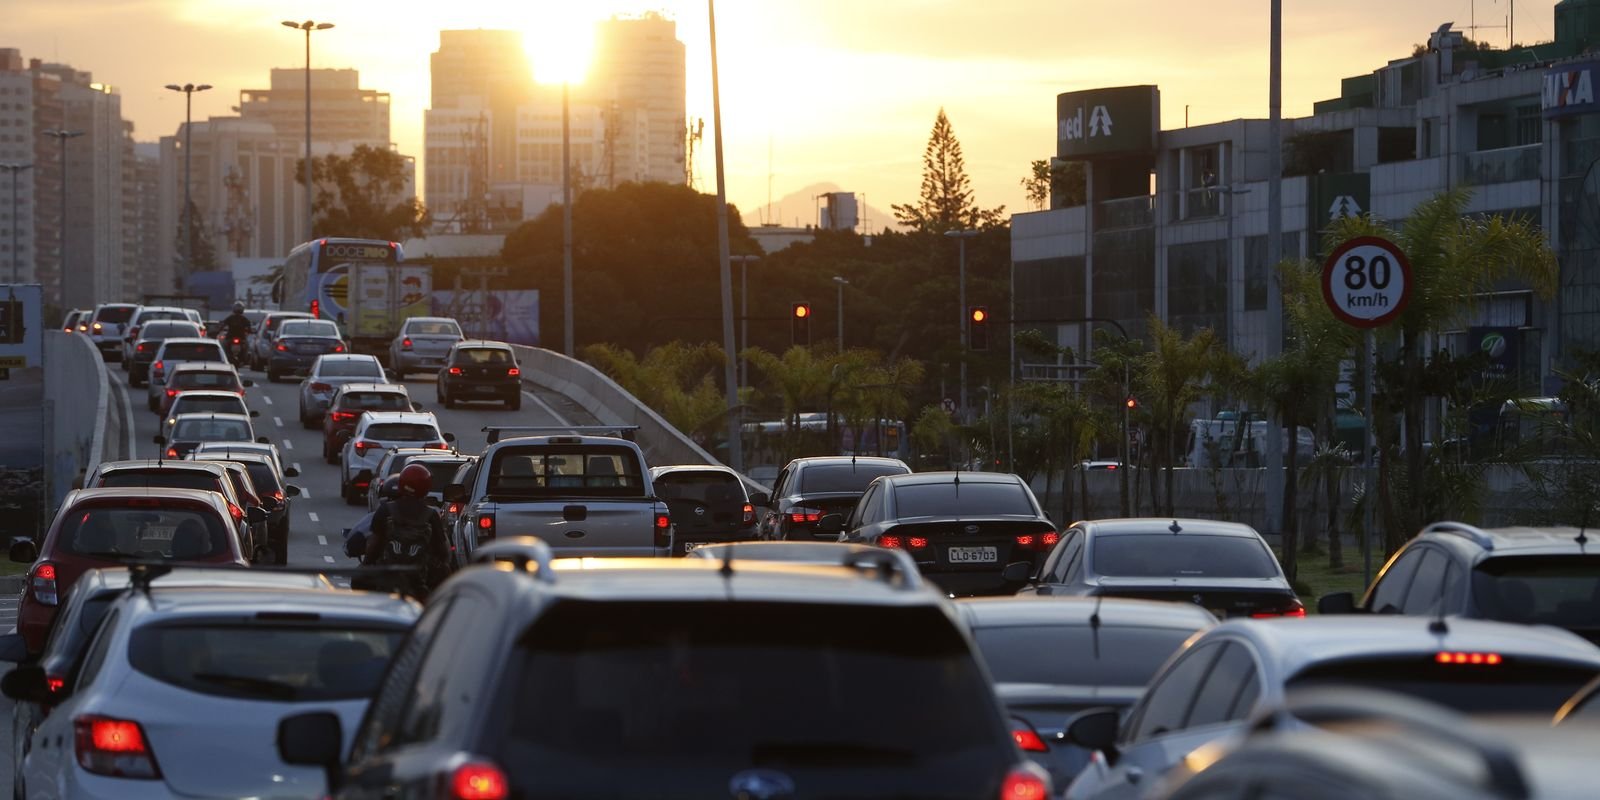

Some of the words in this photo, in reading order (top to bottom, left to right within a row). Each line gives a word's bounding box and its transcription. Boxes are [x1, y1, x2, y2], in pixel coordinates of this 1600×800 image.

[1542, 70, 1594, 108] AIXA
[326, 244, 389, 260] DOCERIO
[1344, 255, 1391, 290] 80
[1347, 292, 1389, 308] km/h
